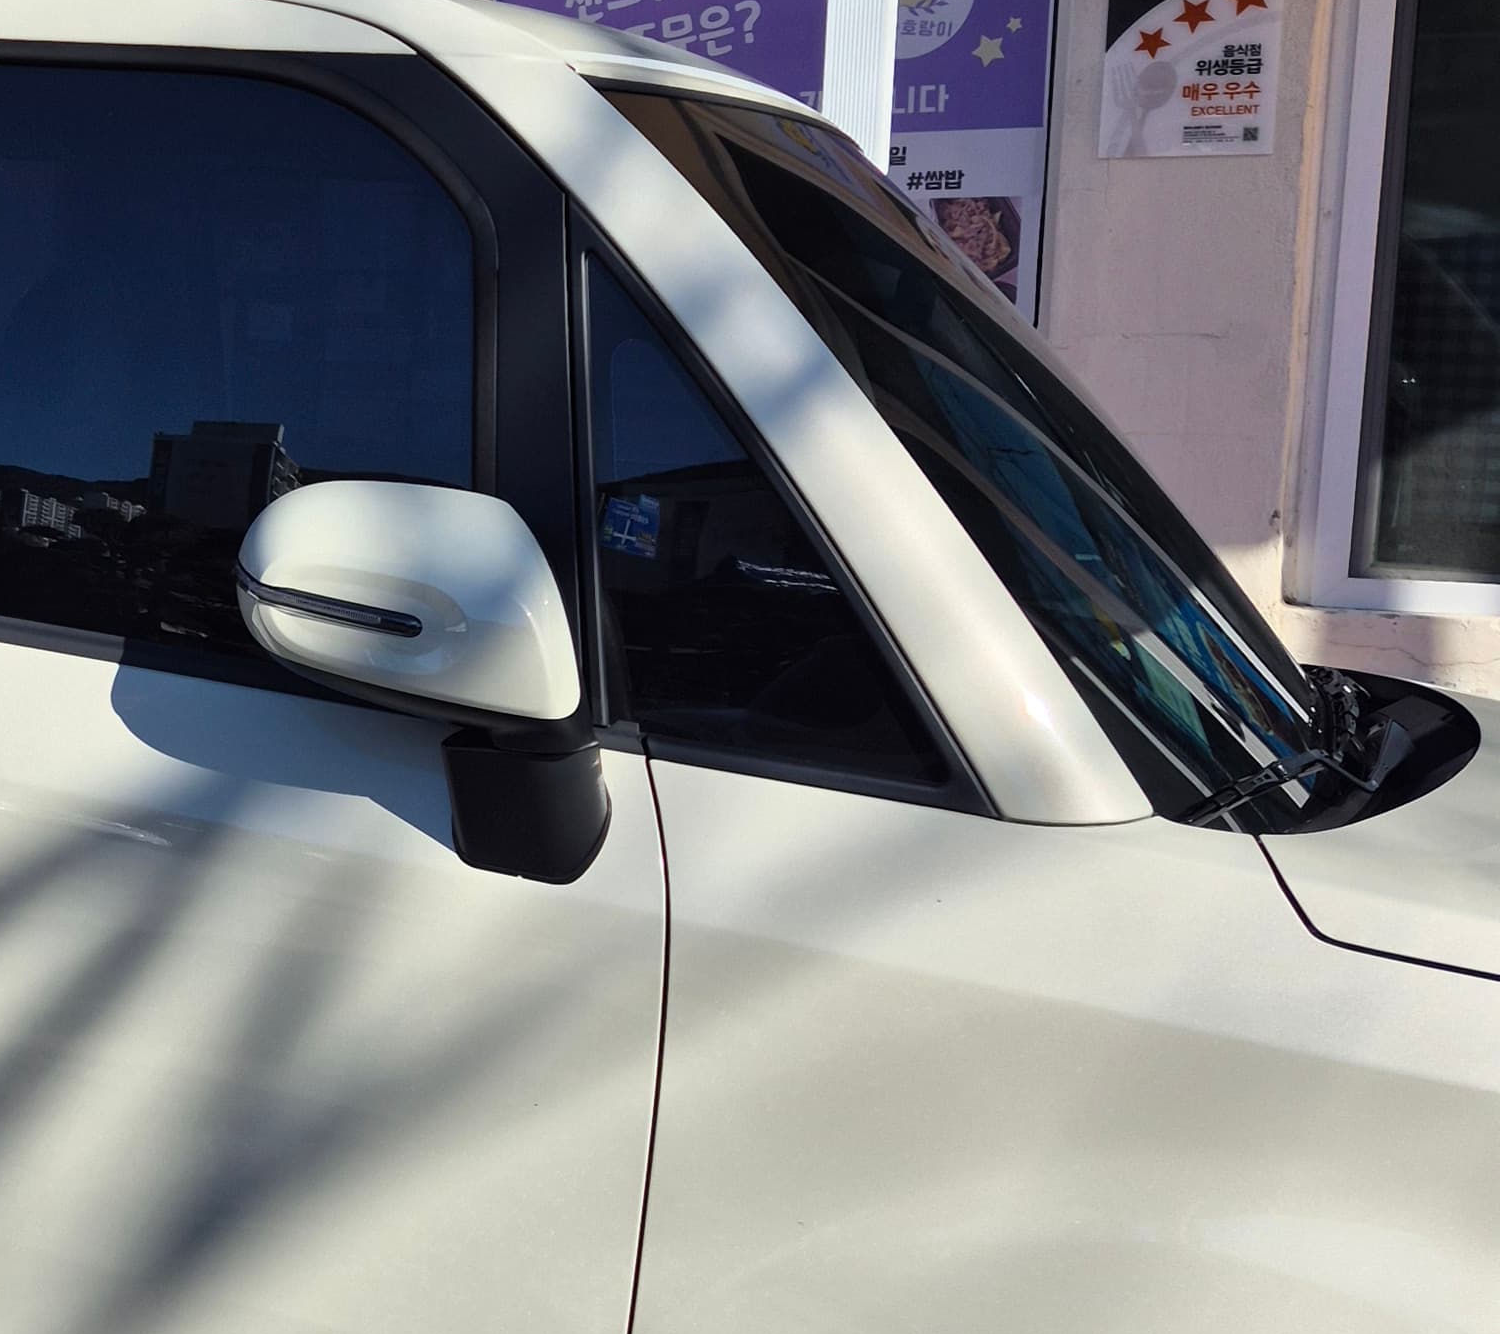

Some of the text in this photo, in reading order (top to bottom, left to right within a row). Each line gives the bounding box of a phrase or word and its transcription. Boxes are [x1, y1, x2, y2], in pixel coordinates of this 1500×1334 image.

[1222, 42, 1262, 58] 음식점
[1194, 58, 1264, 76] 위생등급
[1181, 80, 1262, 101] 매우 우수
[1191, 104, 1261, 117] EXCELLENT
[906, 170, 964, 191] #쌈밥
